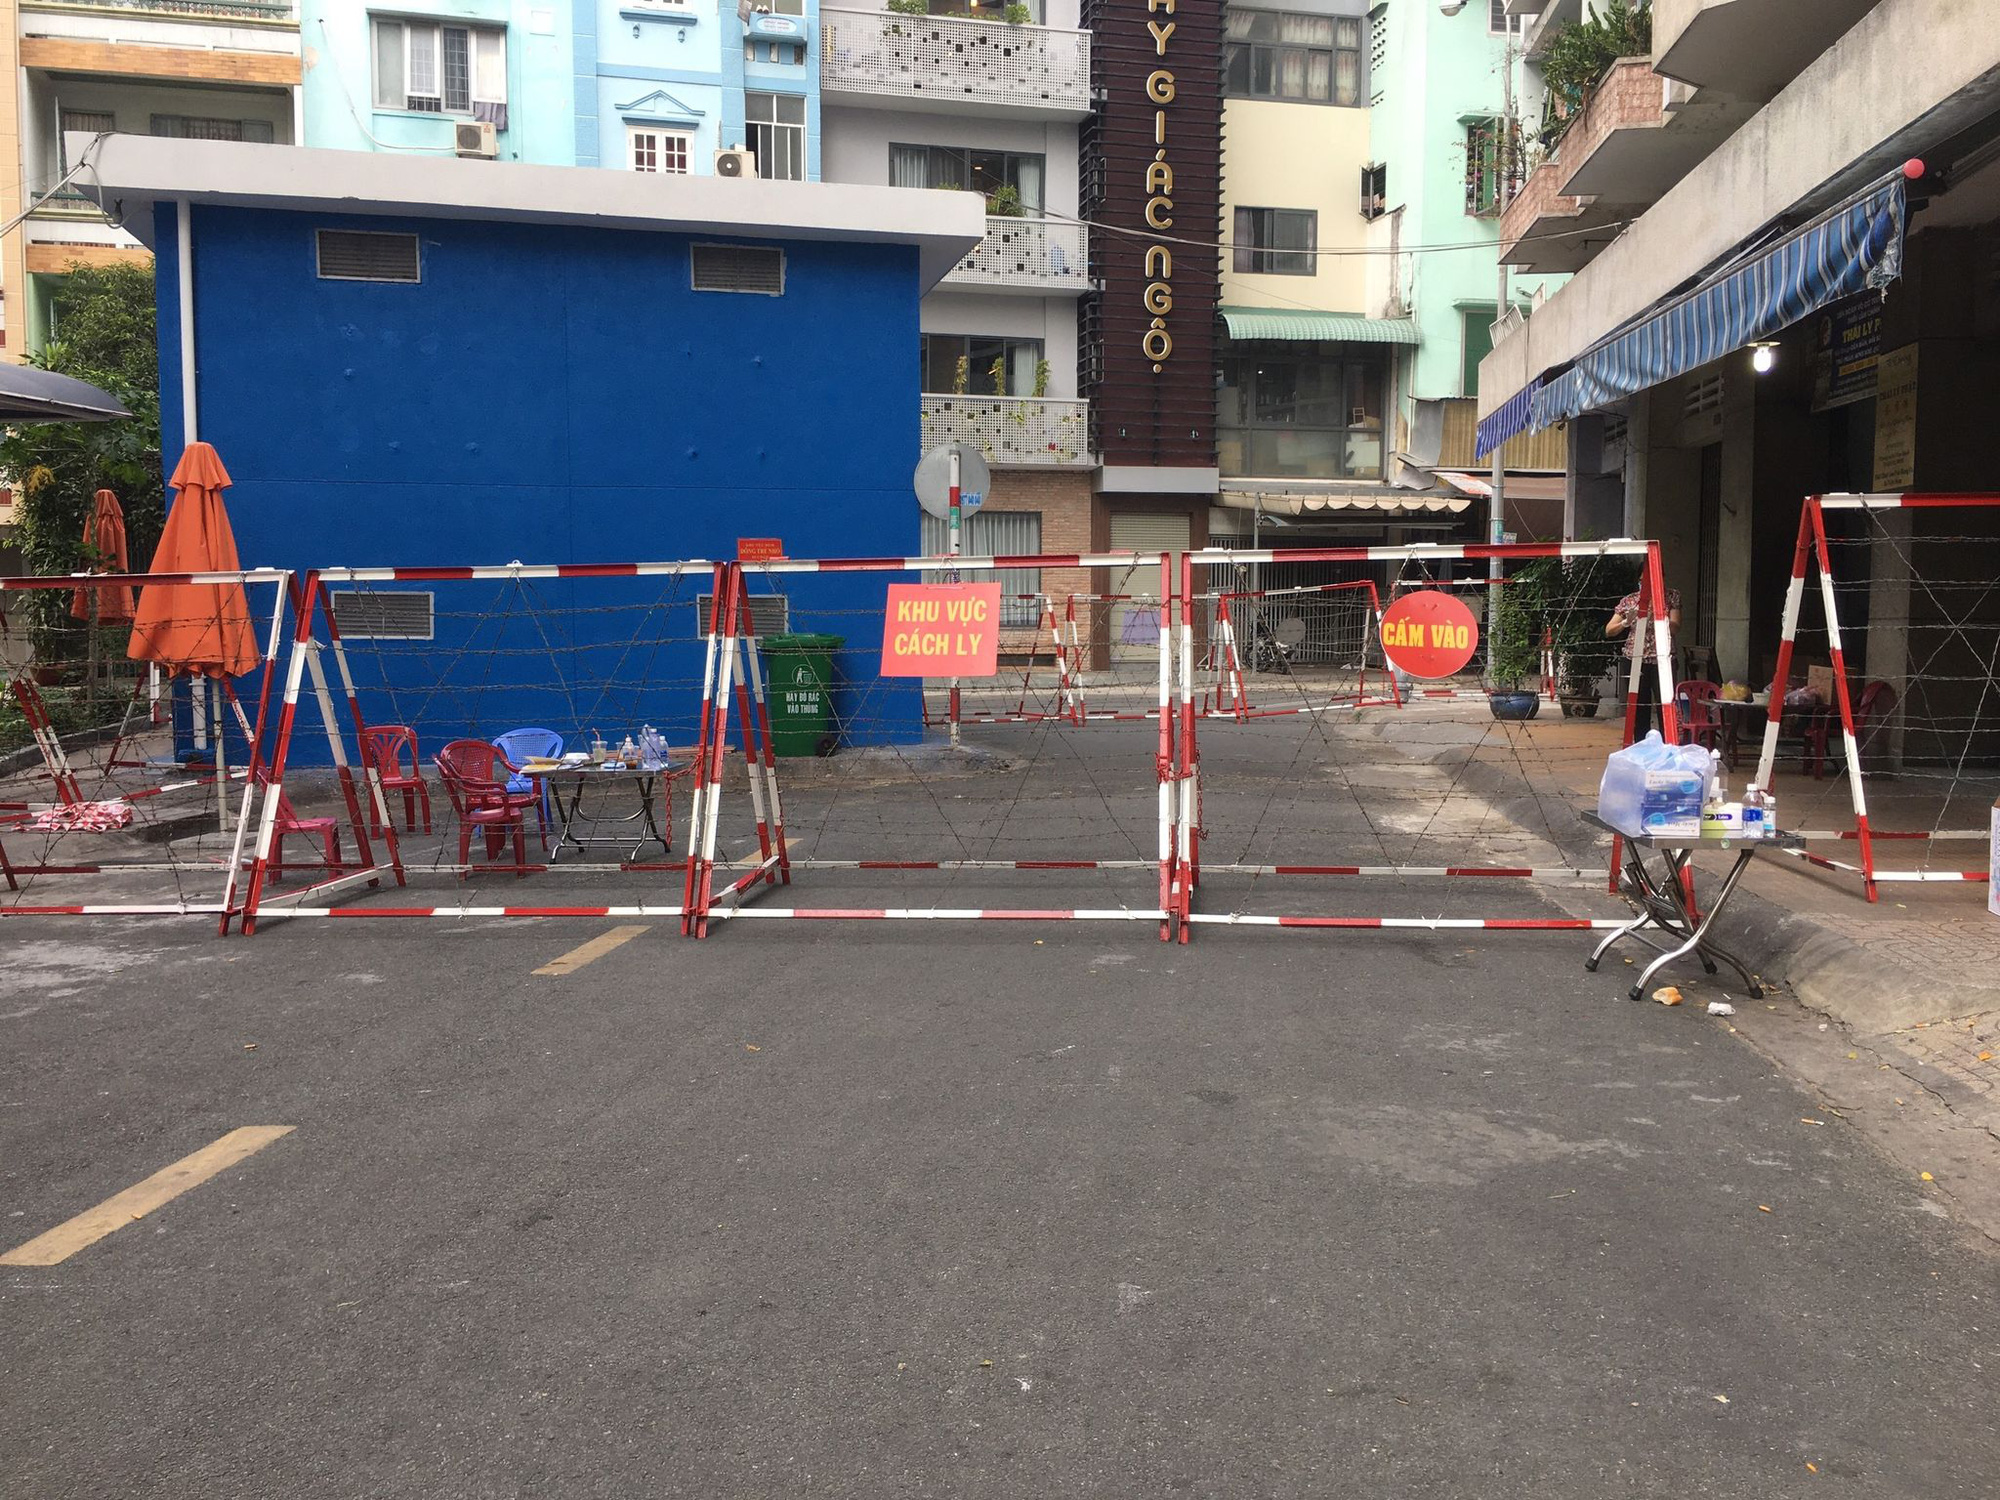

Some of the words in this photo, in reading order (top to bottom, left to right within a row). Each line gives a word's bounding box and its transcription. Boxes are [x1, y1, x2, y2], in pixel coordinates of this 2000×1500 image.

[1145, 69, 1176, 230] GIÁC
[1142, 244, 1173, 374] NGỘ
[897, 600, 940, 622] KHU
[946, 596, 988, 627] VỰC
[894, 628, 950, 656] CÁCH
[956, 633, 983, 656] LY
[1382, 616, 1425, 648] CẤM
[1431, 619, 1469, 650] VÀO
